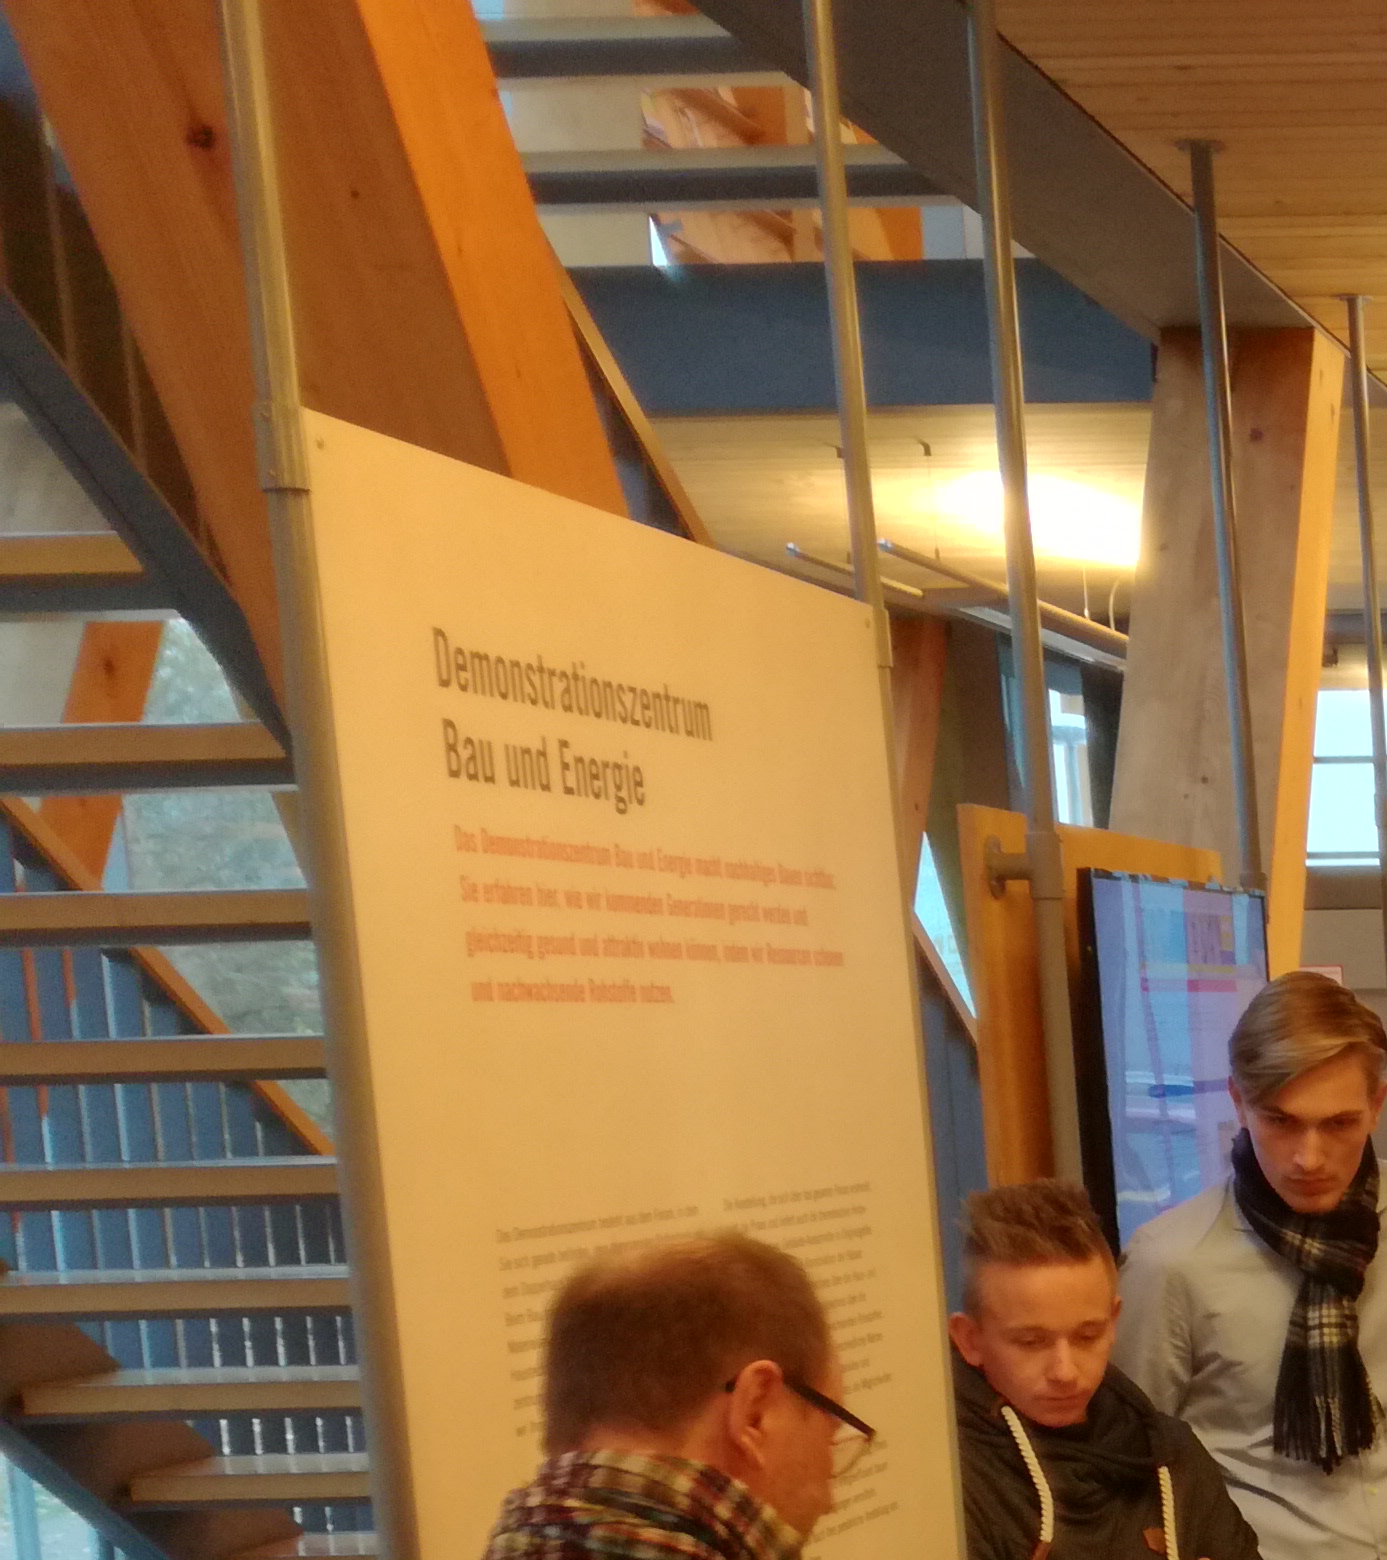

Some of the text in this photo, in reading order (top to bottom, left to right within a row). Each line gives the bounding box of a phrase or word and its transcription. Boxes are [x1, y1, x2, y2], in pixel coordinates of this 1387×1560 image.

[433, 626, 713, 742] Demonstrationszentrum
[442, 717, 645, 815] Bau und Energie
